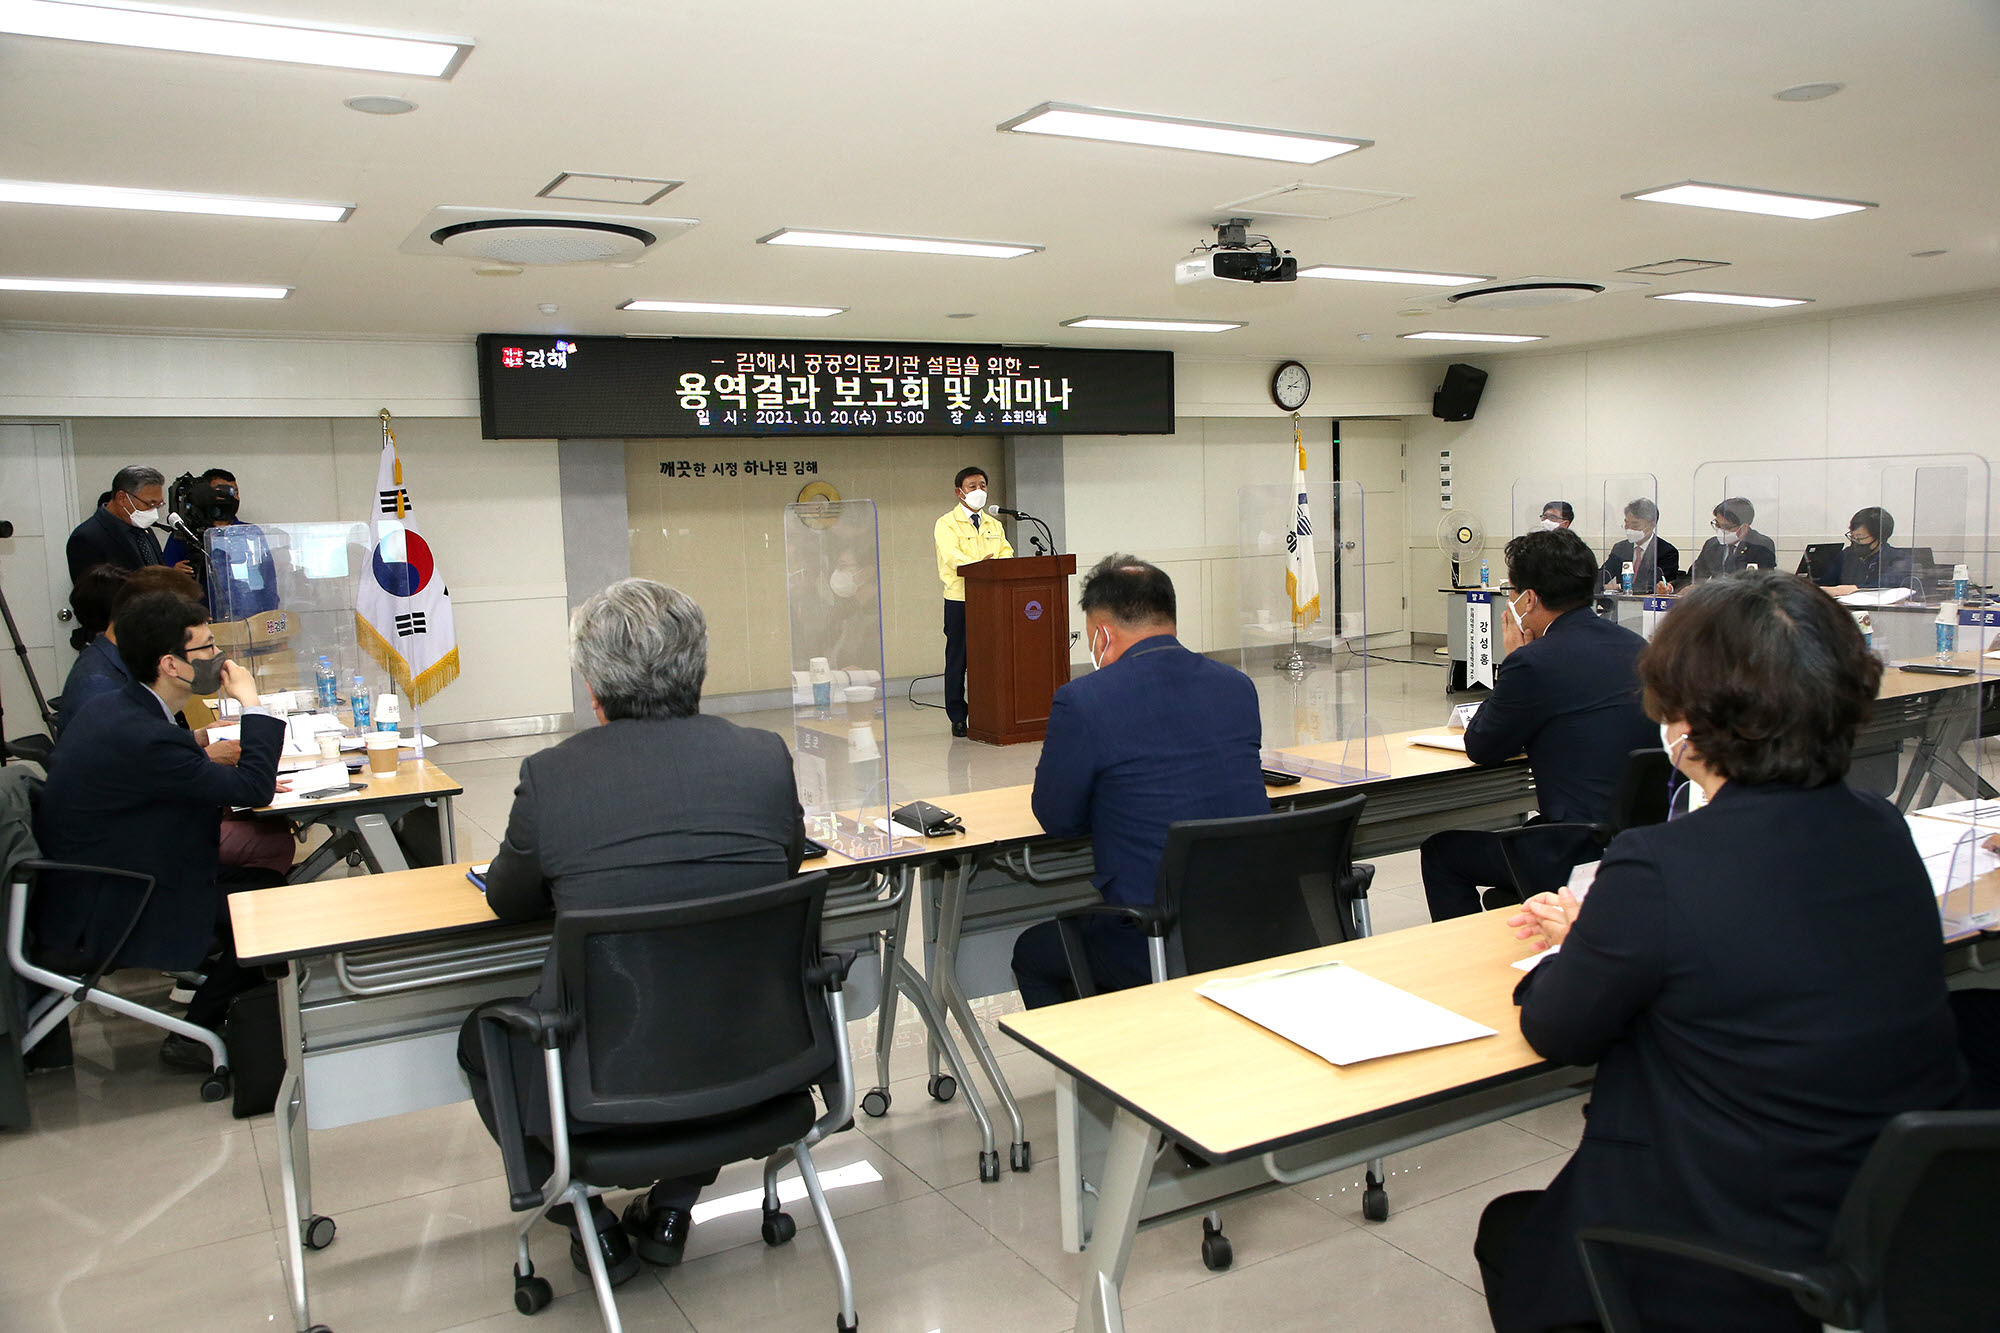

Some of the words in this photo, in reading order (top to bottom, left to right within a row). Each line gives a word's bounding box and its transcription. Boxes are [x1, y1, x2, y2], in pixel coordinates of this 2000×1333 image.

[524, 348, 567, 369] 김해
[736, 352, 796, 374] 김해시
[804, 354, 920, 376] 공공의료기관
[926, 355, 980, 376] 설립을
[987, 357, 1022, 377] 위한
[676, 373, 821, 410] 용역결과
[832, 376, 930, 410] 보고회
[944, 376, 972, 411] 및
[982, 377, 1073, 410] 세미나
[696, 410, 710, 426] 일
[756, 410, 798, 425] 2021.
[803, 410, 826, 425] 10.
[886, 411, 925, 424] 15:00
[1001, 410, 1048, 425] 소회의실
[660, 460, 706, 478] 깨끗한
[712, 460, 738, 477] 시정
[743, 460, 788, 476] 하나된
[793, 460, 818, 475] 김해
